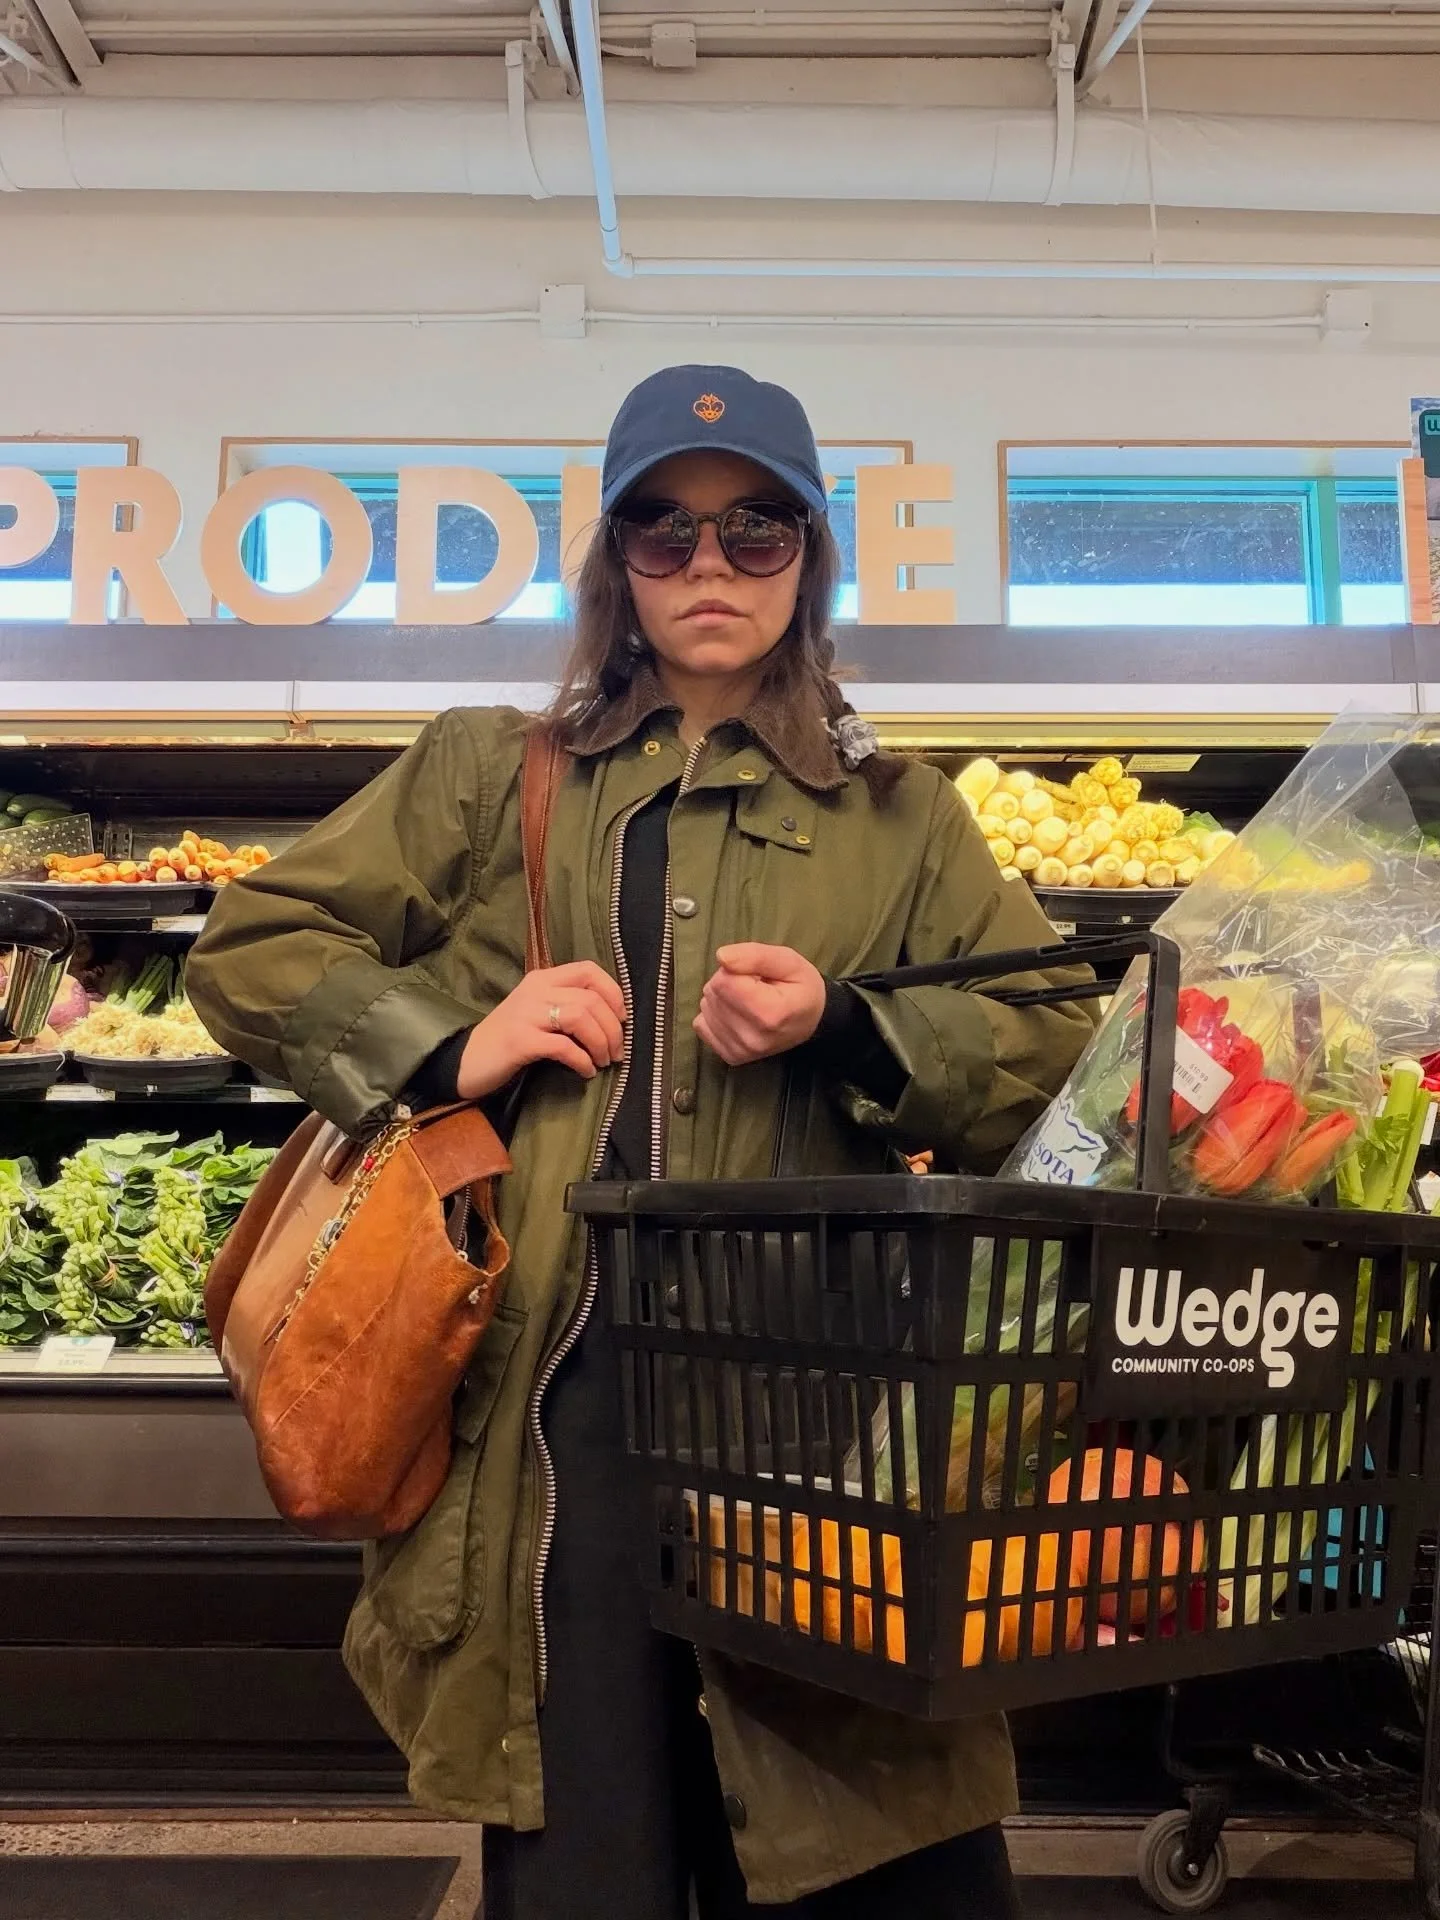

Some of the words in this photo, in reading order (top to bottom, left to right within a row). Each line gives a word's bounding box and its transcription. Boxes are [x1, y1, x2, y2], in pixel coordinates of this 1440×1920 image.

[0, 464, 955, 626] PRODE
[1033, 1142, 1075, 1185] SOTA
[1111, 1357, 1199, 1373] COMMUNITY
[1202, 1358, 1255, 1373] CO-OPS
[1115, 1267, 1340, 1388] Wedge
